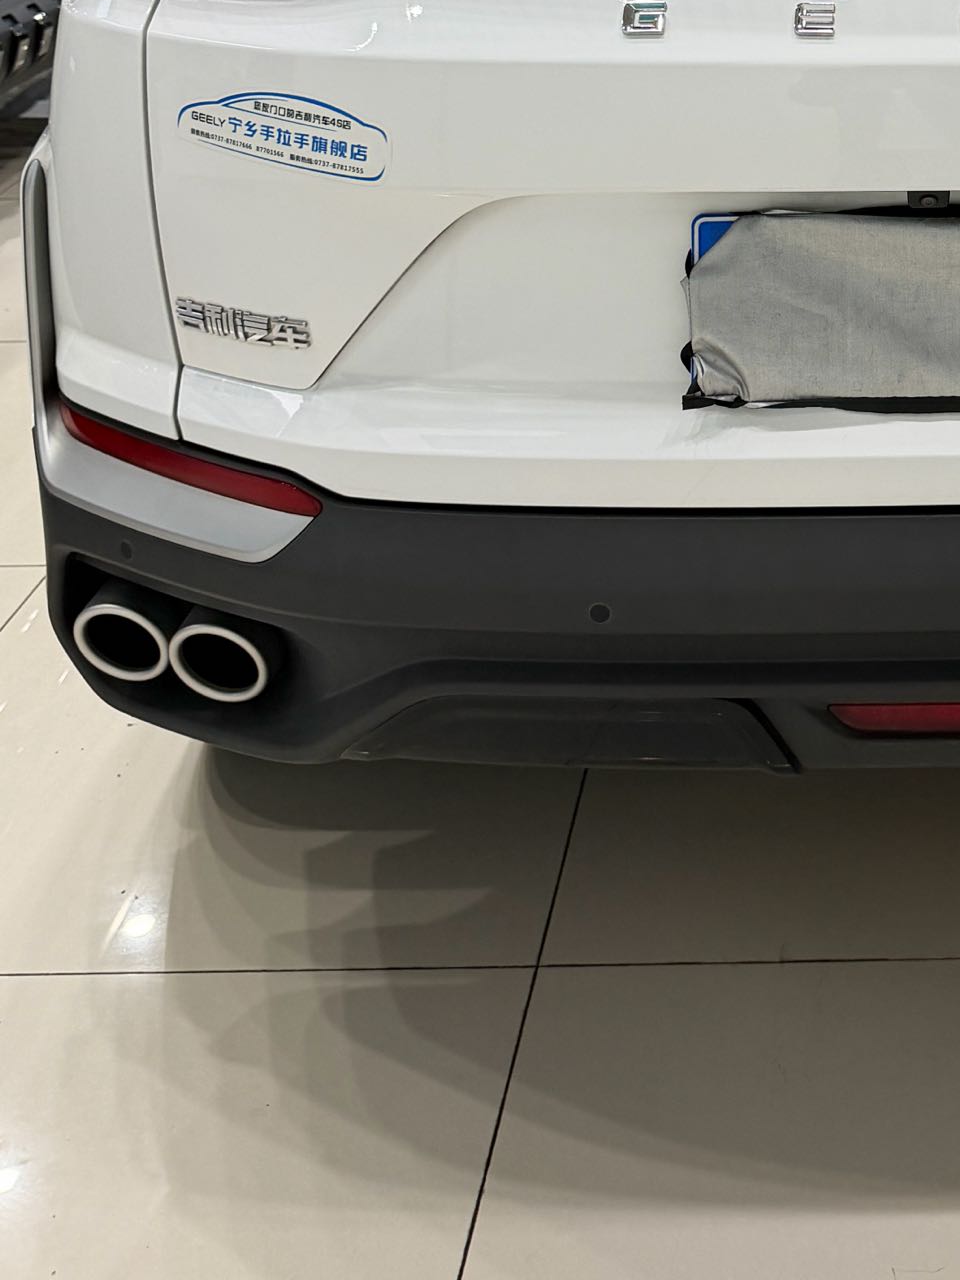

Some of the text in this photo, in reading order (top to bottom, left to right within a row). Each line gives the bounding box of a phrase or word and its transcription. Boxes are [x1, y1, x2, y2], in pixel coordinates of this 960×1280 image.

[191, 110, 368, 162] GEELY 宁乡手拉手旗舰店
[176, 298, 311, 349] 吉利汽车
